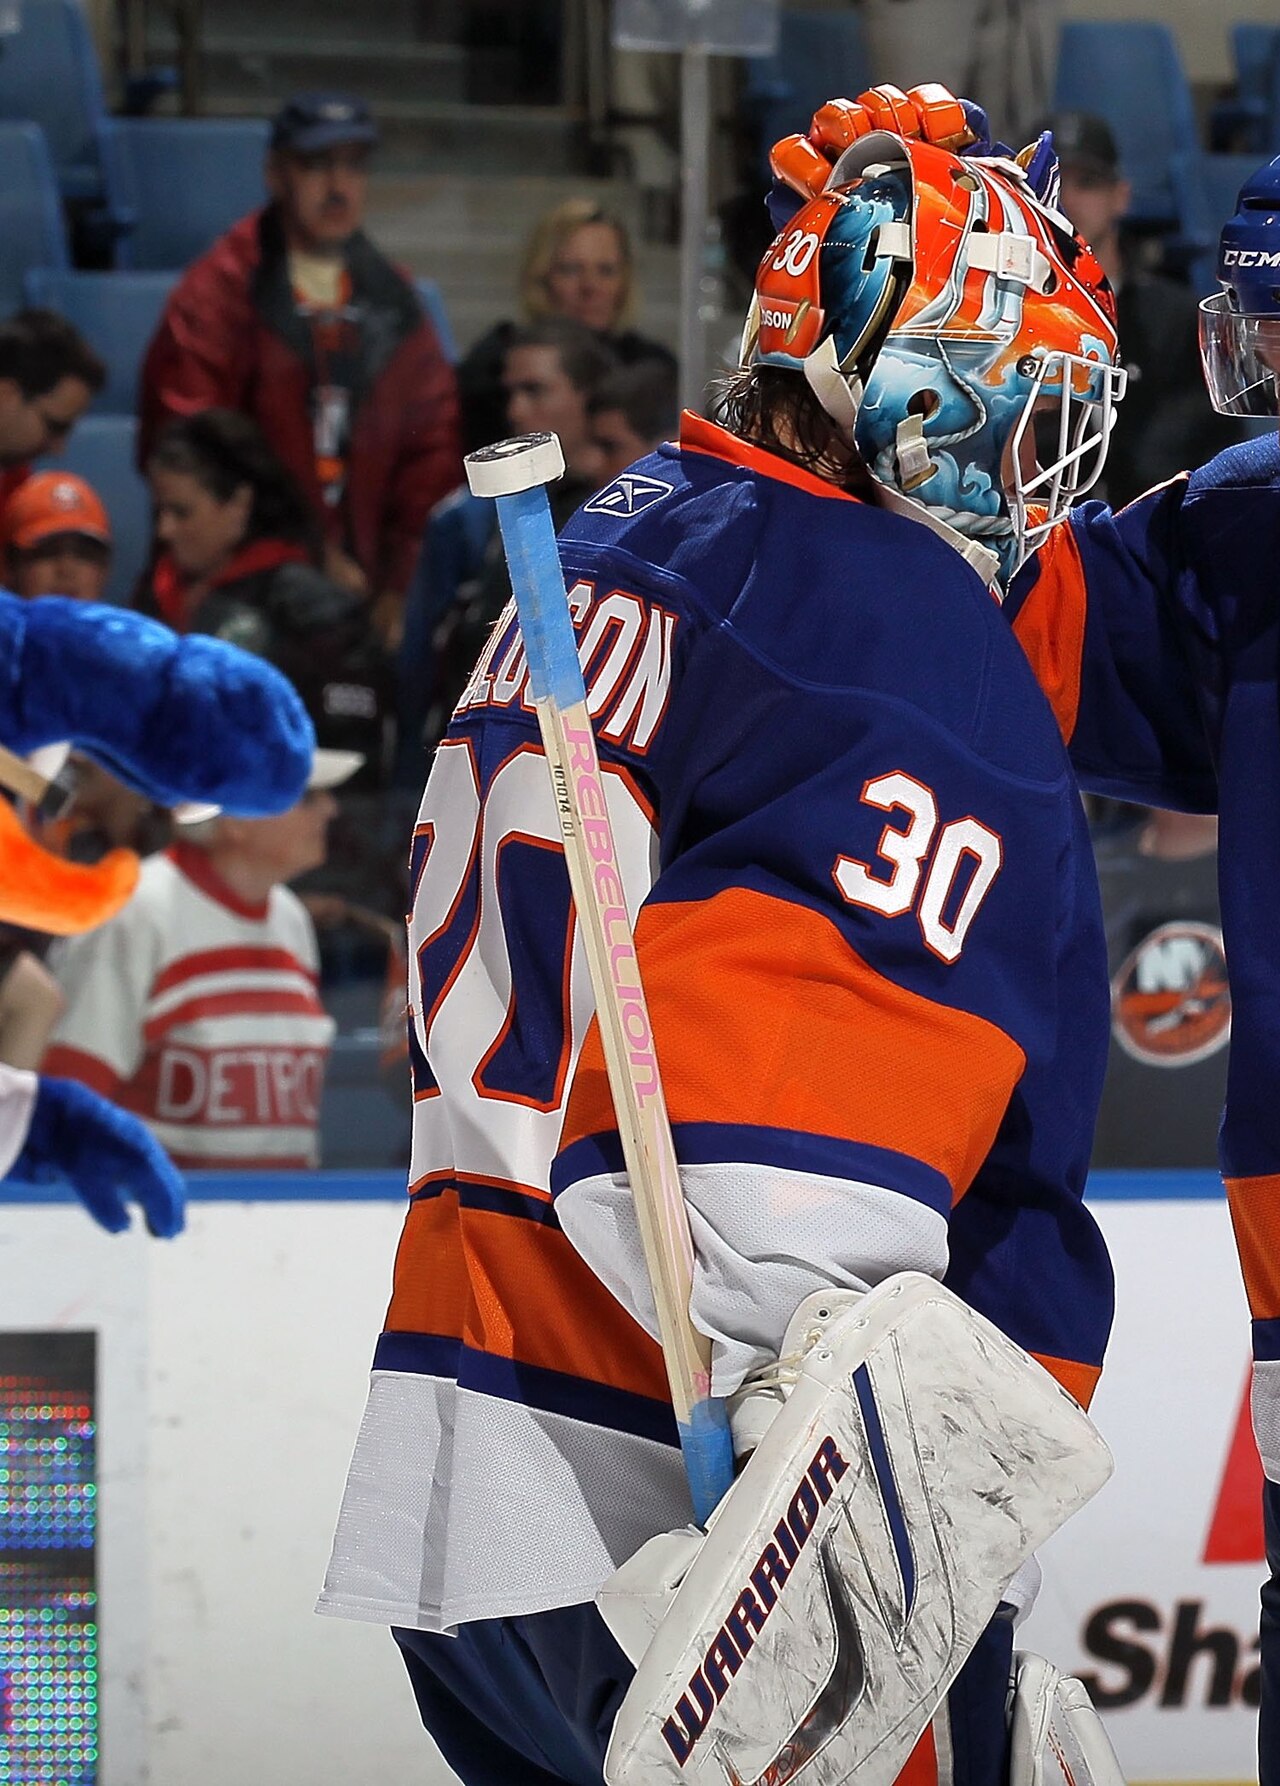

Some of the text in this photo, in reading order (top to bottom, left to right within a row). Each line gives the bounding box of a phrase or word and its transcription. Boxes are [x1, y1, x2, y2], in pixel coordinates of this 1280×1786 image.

[772, 229, 819, 276] 30
[562, 716, 660, 1108] REBELLION
[831, 769, 1004, 965] 30
[661, 1436, 850, 1768] WARRIOR
